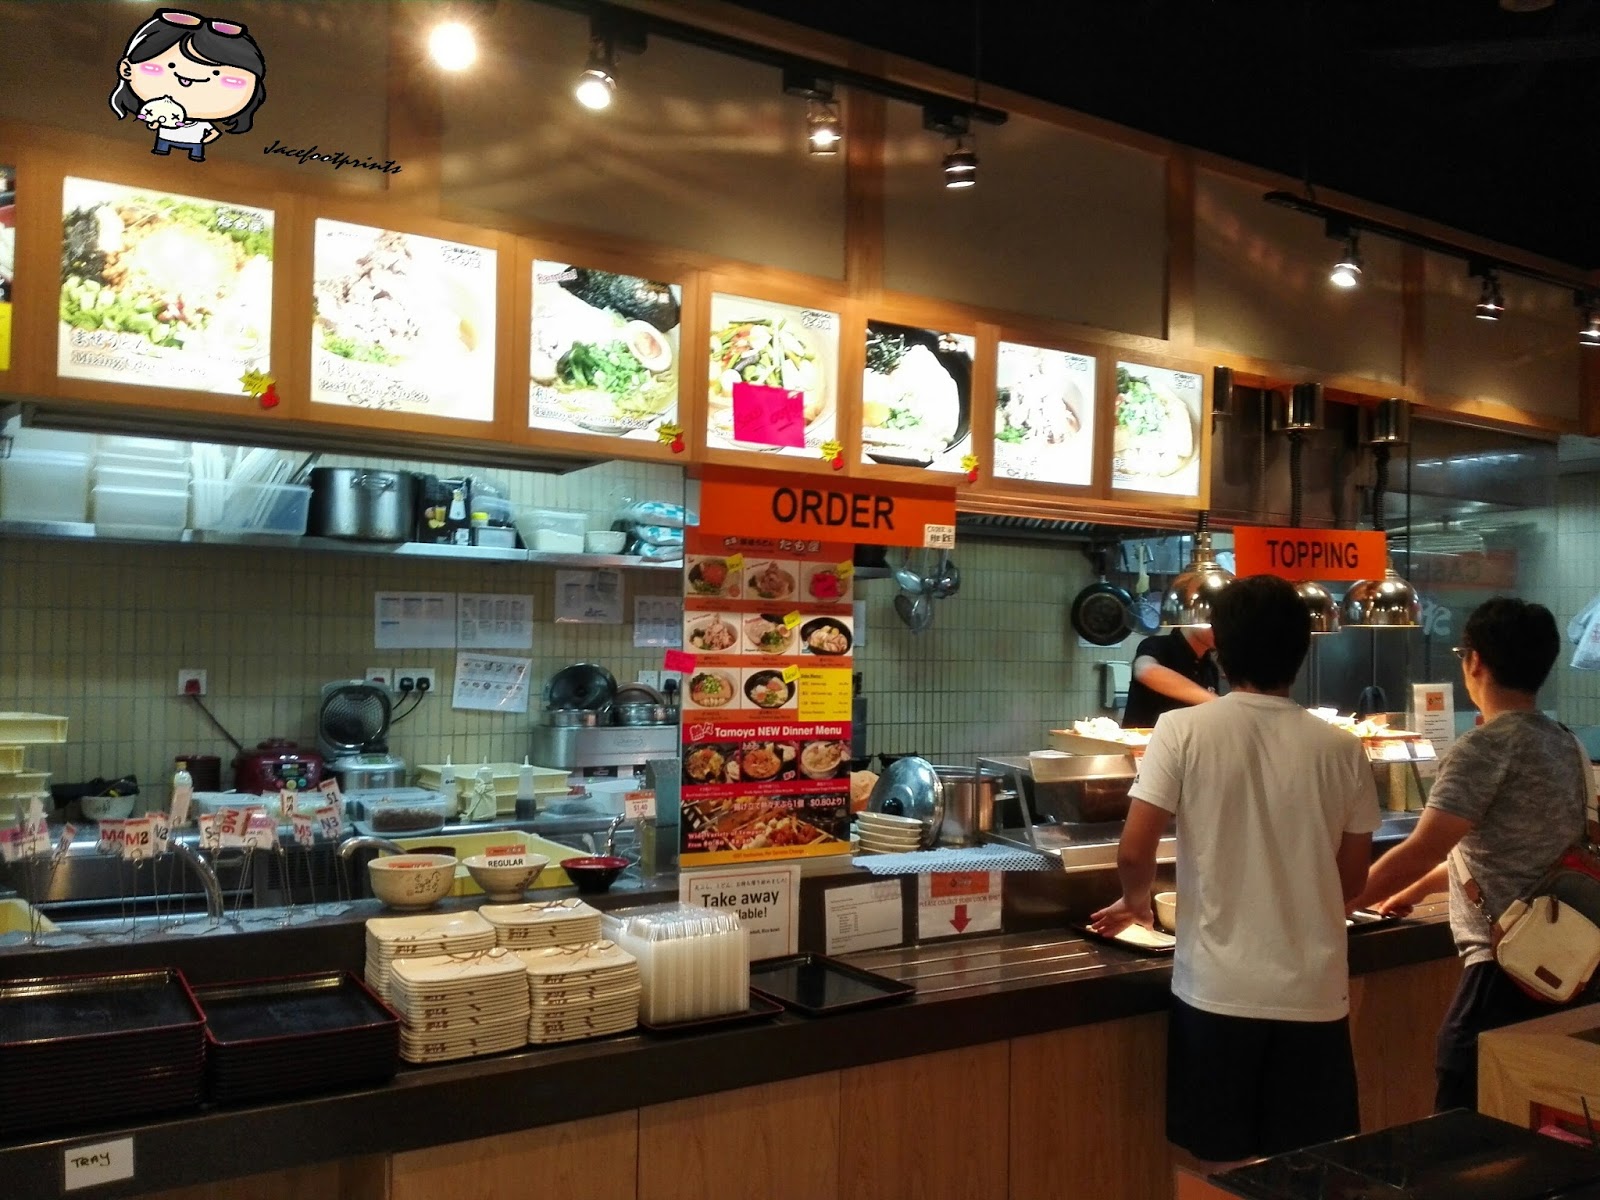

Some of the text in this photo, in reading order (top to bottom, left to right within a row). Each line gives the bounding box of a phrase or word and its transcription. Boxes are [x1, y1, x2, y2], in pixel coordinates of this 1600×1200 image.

[772, 487, 895, 531] ORDER
[1267, 540, 1360, 569] TOPPING
[715, 724, 842, 739] Tamoya NEW Dinner Menu
[101, 829, 125, 842] M4
[125, 831, 149, 846] M2
[488, 858, 524, 868] REGULAR
[701, 890, 780, 908] Take away
[737, 906, 768, 920] lable!
[71, 1152, 111, 1169] TRAY
